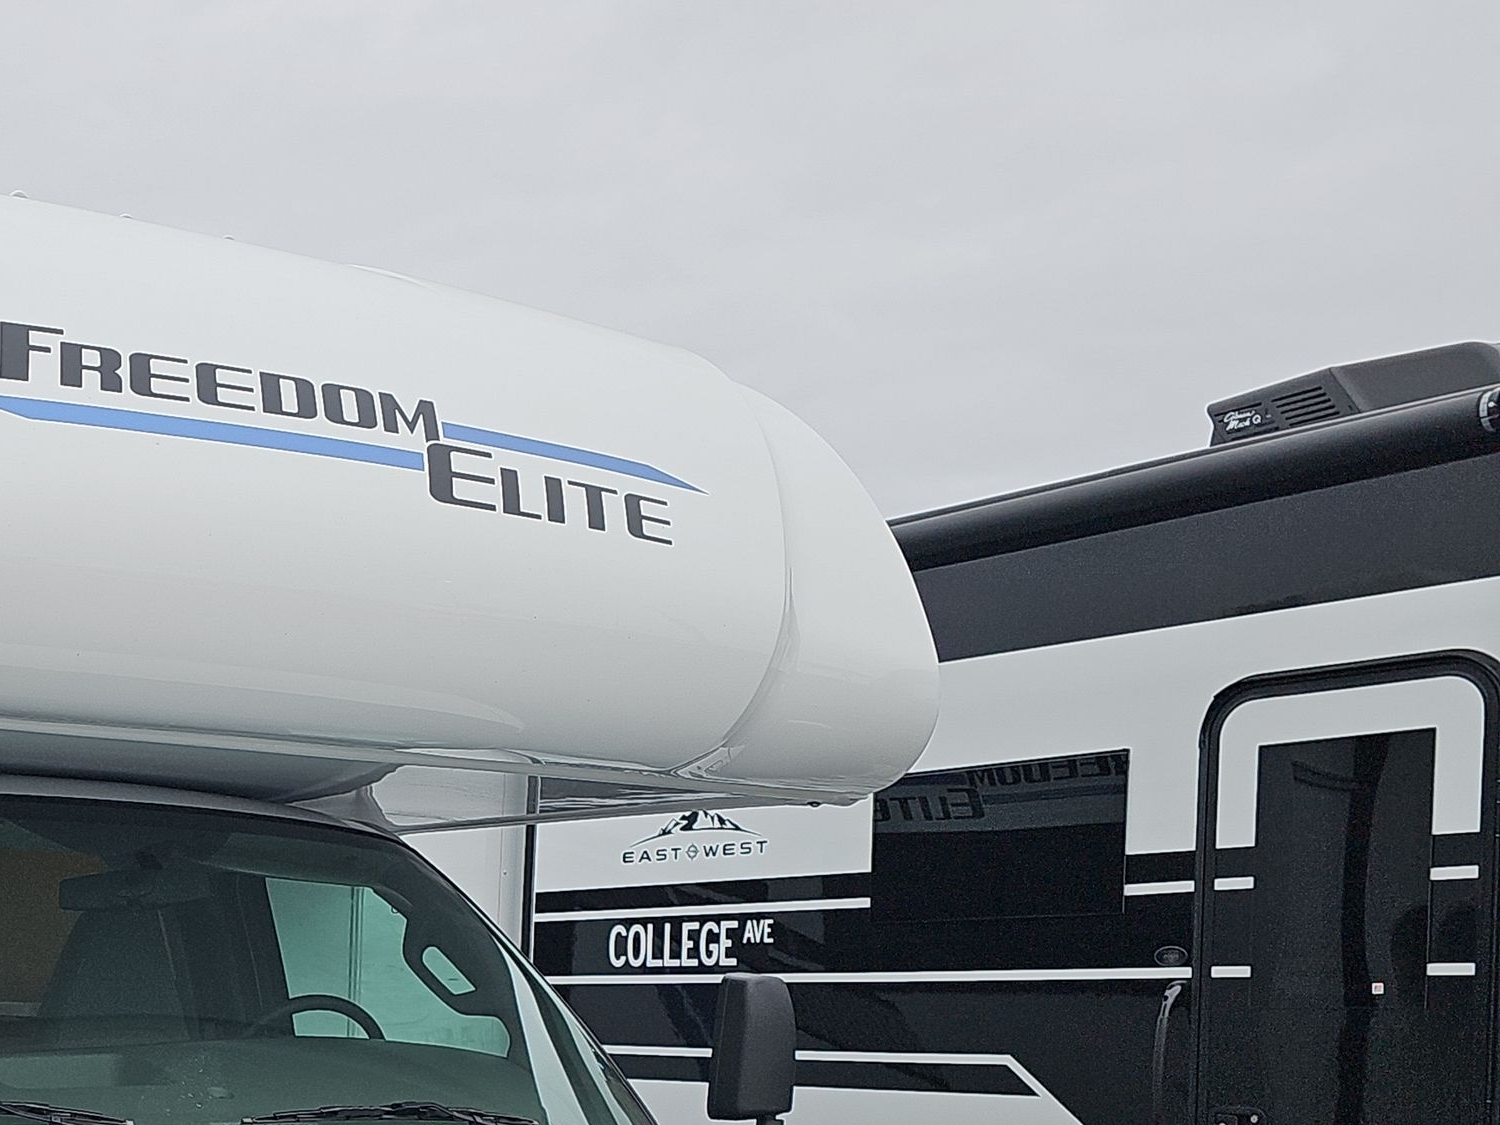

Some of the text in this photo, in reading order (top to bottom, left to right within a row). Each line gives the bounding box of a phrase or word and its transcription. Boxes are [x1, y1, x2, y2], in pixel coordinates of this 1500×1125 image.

[428, 442, 673, 547] ELITE
[622, 840, 768, 864] EAST WEST
[609, 918, 775, 968] COLLEGE AVE
